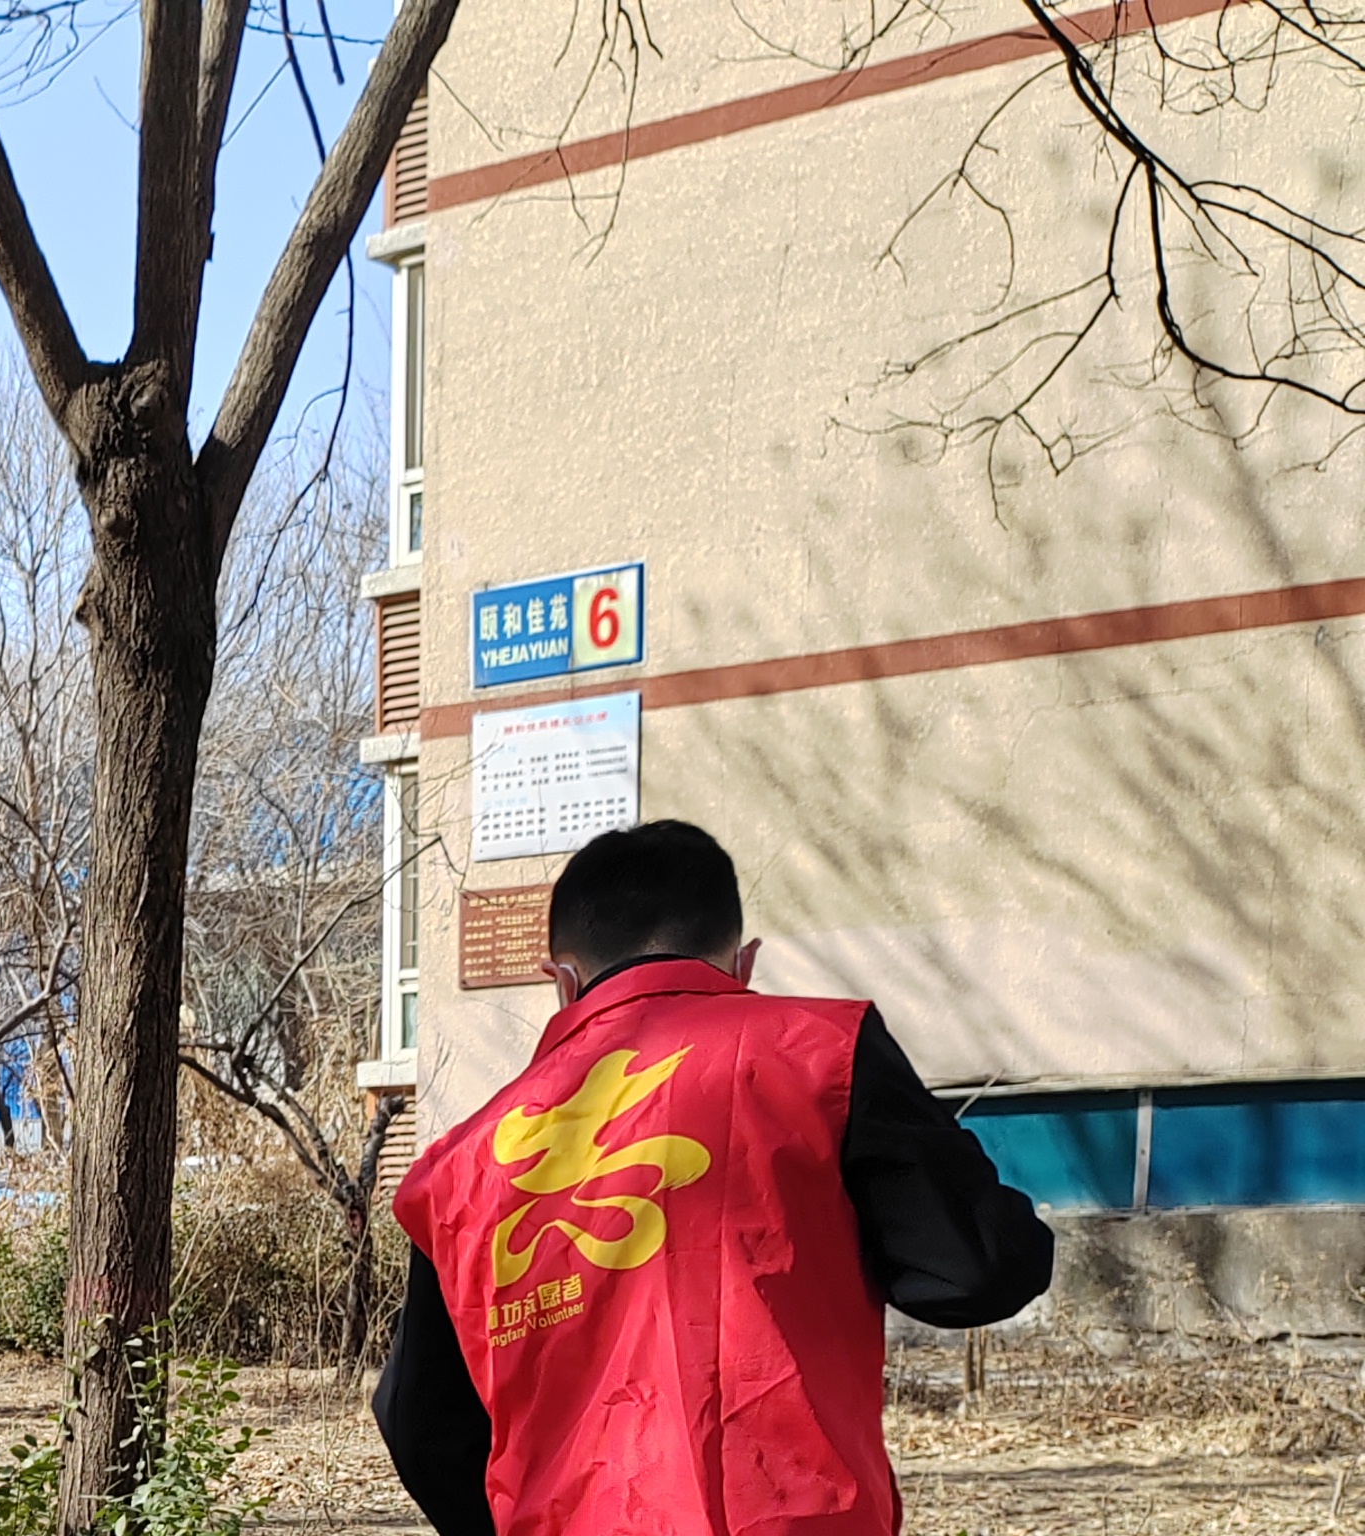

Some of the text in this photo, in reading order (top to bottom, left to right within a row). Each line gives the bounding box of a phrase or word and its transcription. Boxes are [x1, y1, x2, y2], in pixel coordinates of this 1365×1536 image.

[479, 592, 568, 641] 颐和佳苑
[589, 587, 619, 650] 6
[480, 637, 568, 669] YIHEJIAYUAN
[526, 1301, 585, 1330] Volunteer
